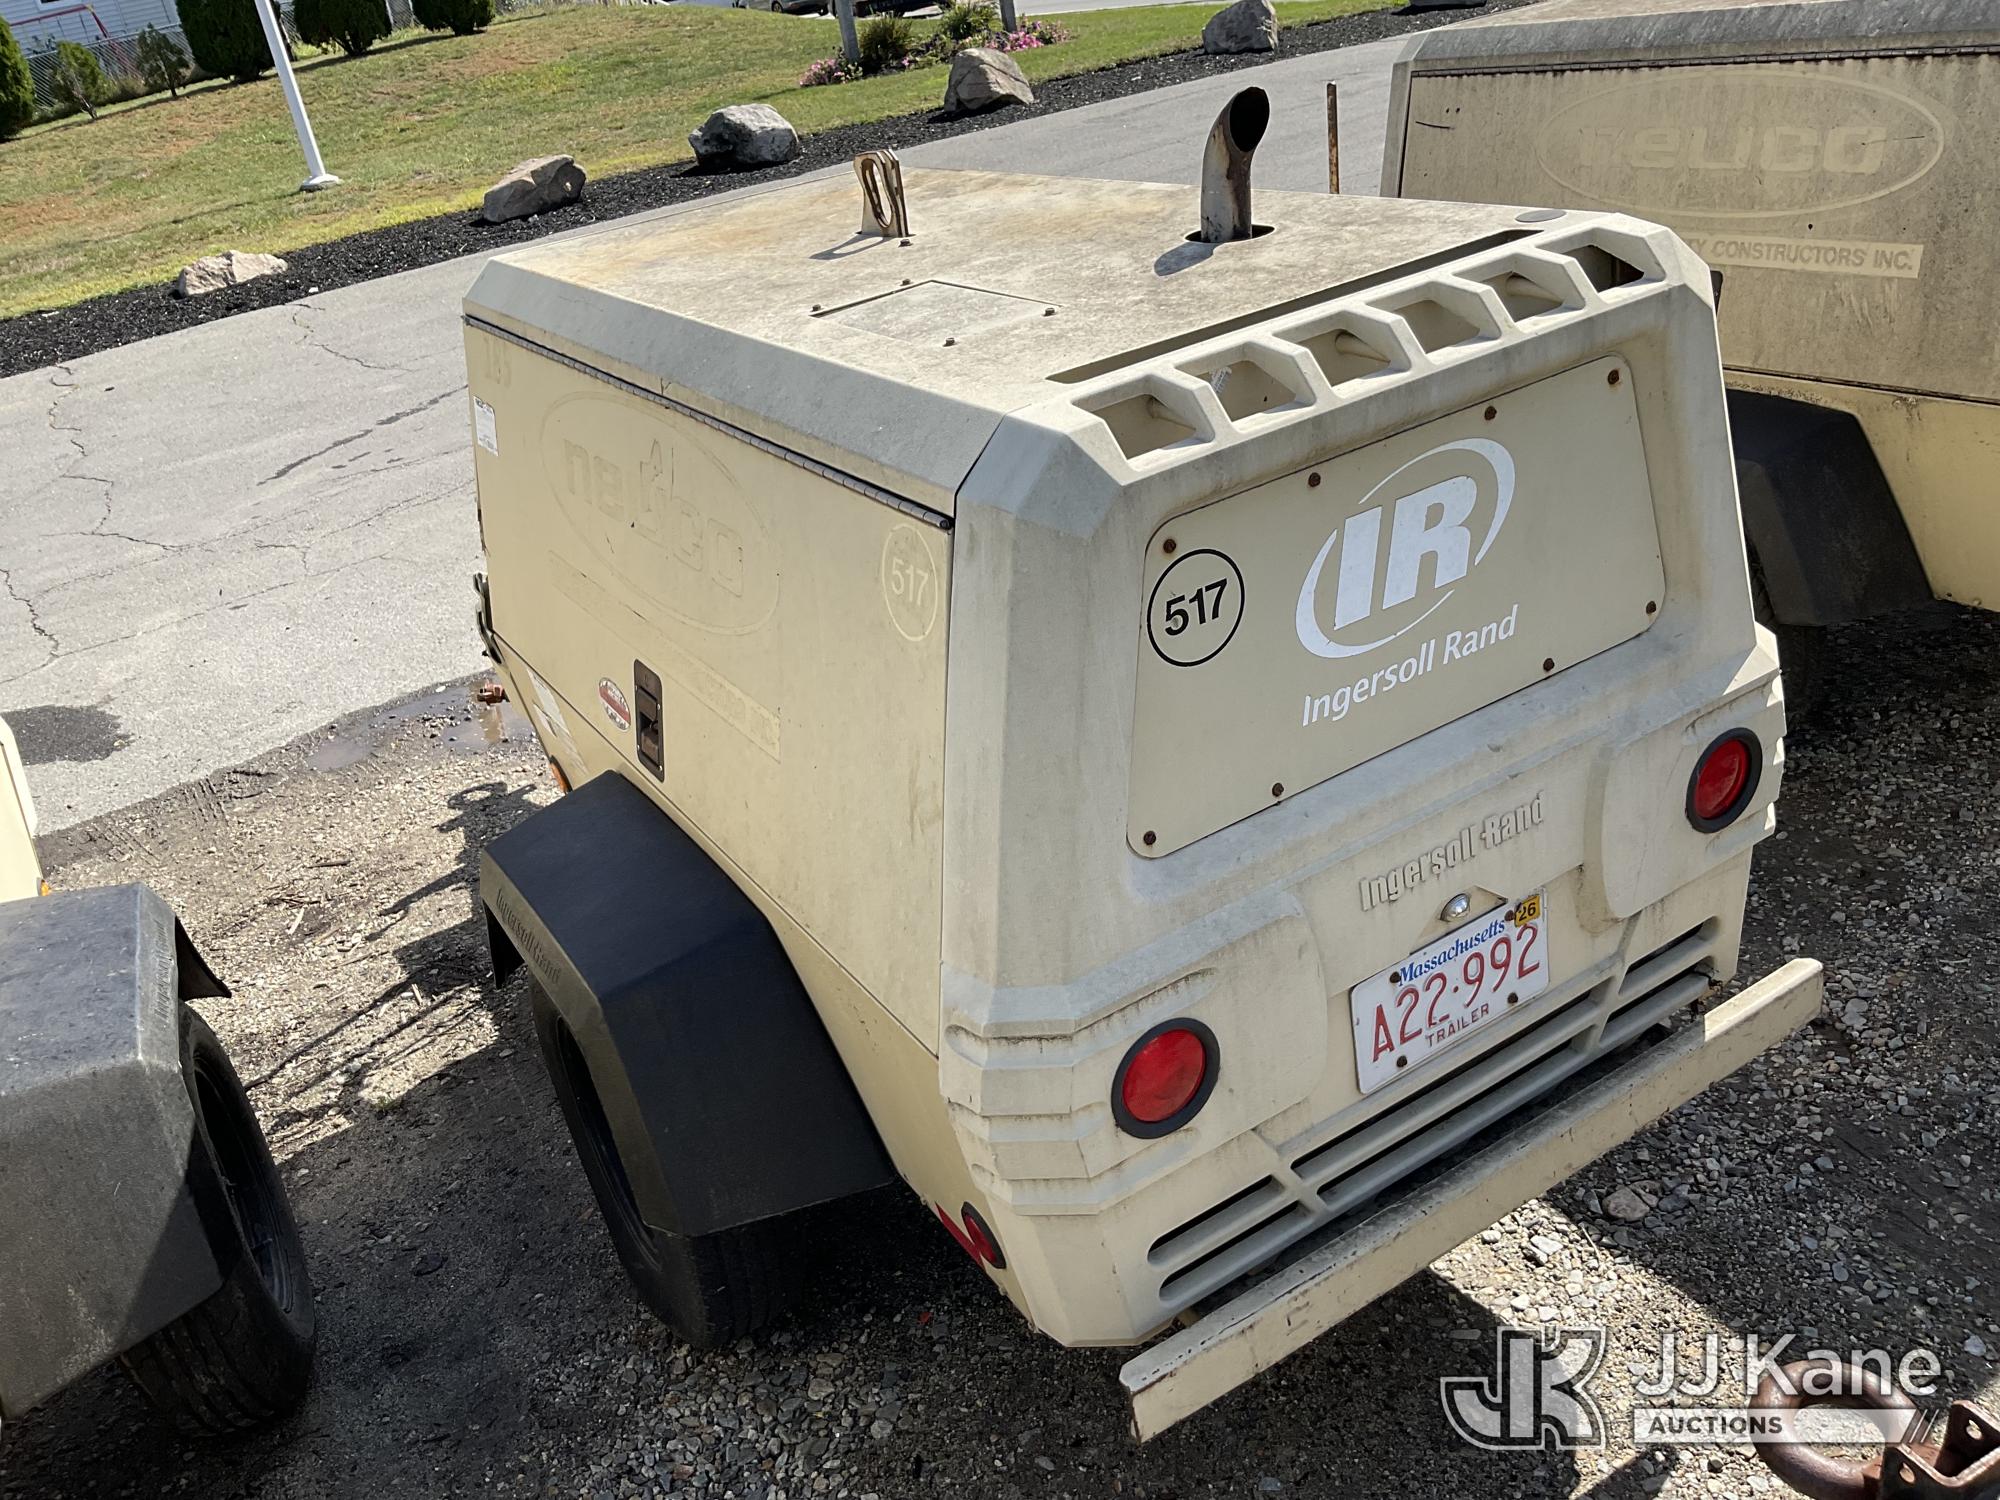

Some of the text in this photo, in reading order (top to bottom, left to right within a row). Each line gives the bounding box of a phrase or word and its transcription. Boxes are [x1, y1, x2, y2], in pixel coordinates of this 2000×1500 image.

[1711, 240, 1867, 267] CONSTRUCTORS
[1872, 250, 1914, 271] INC.
[1334, 475, 1478, 630] IR
[891, 557, 929, 606] 517
[1164, 578, 1228, 637] 517
[1302, 603, 1518, 727] Ingersoll Rand
[1518, 902, 1537, 923] 26
[1398, 918, 1506, 987] Massachusetts
[1425, 1003, 1490, 1048] TRAILER
